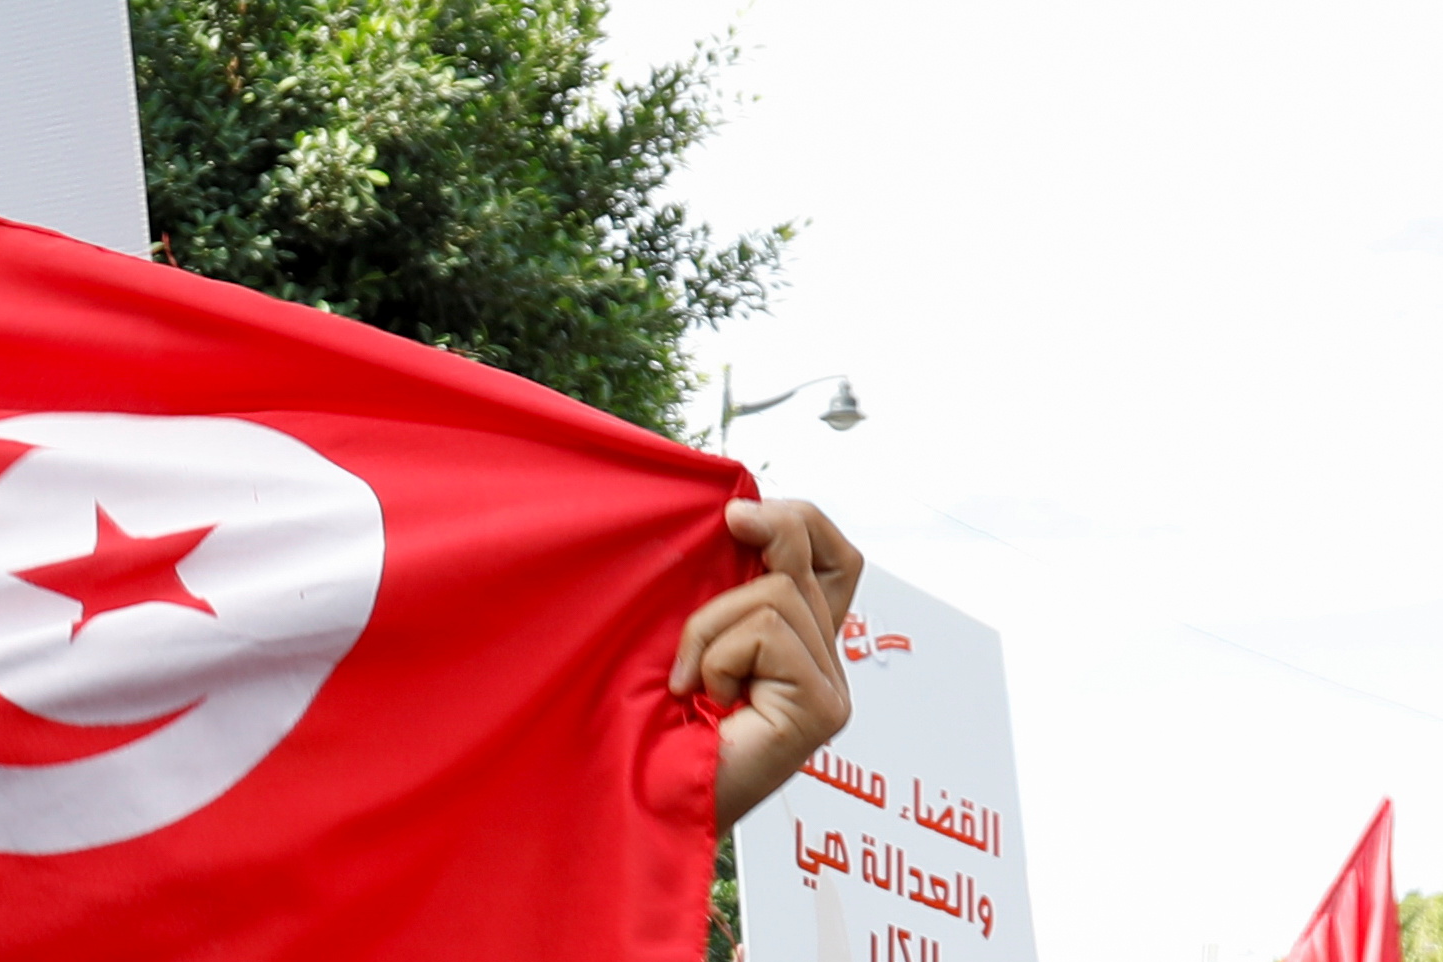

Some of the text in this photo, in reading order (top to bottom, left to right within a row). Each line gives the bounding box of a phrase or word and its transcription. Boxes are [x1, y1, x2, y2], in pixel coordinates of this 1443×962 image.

[899, 776, 1000, 858] القضاء
[795, 817, 994, 940] والعدالة هي
